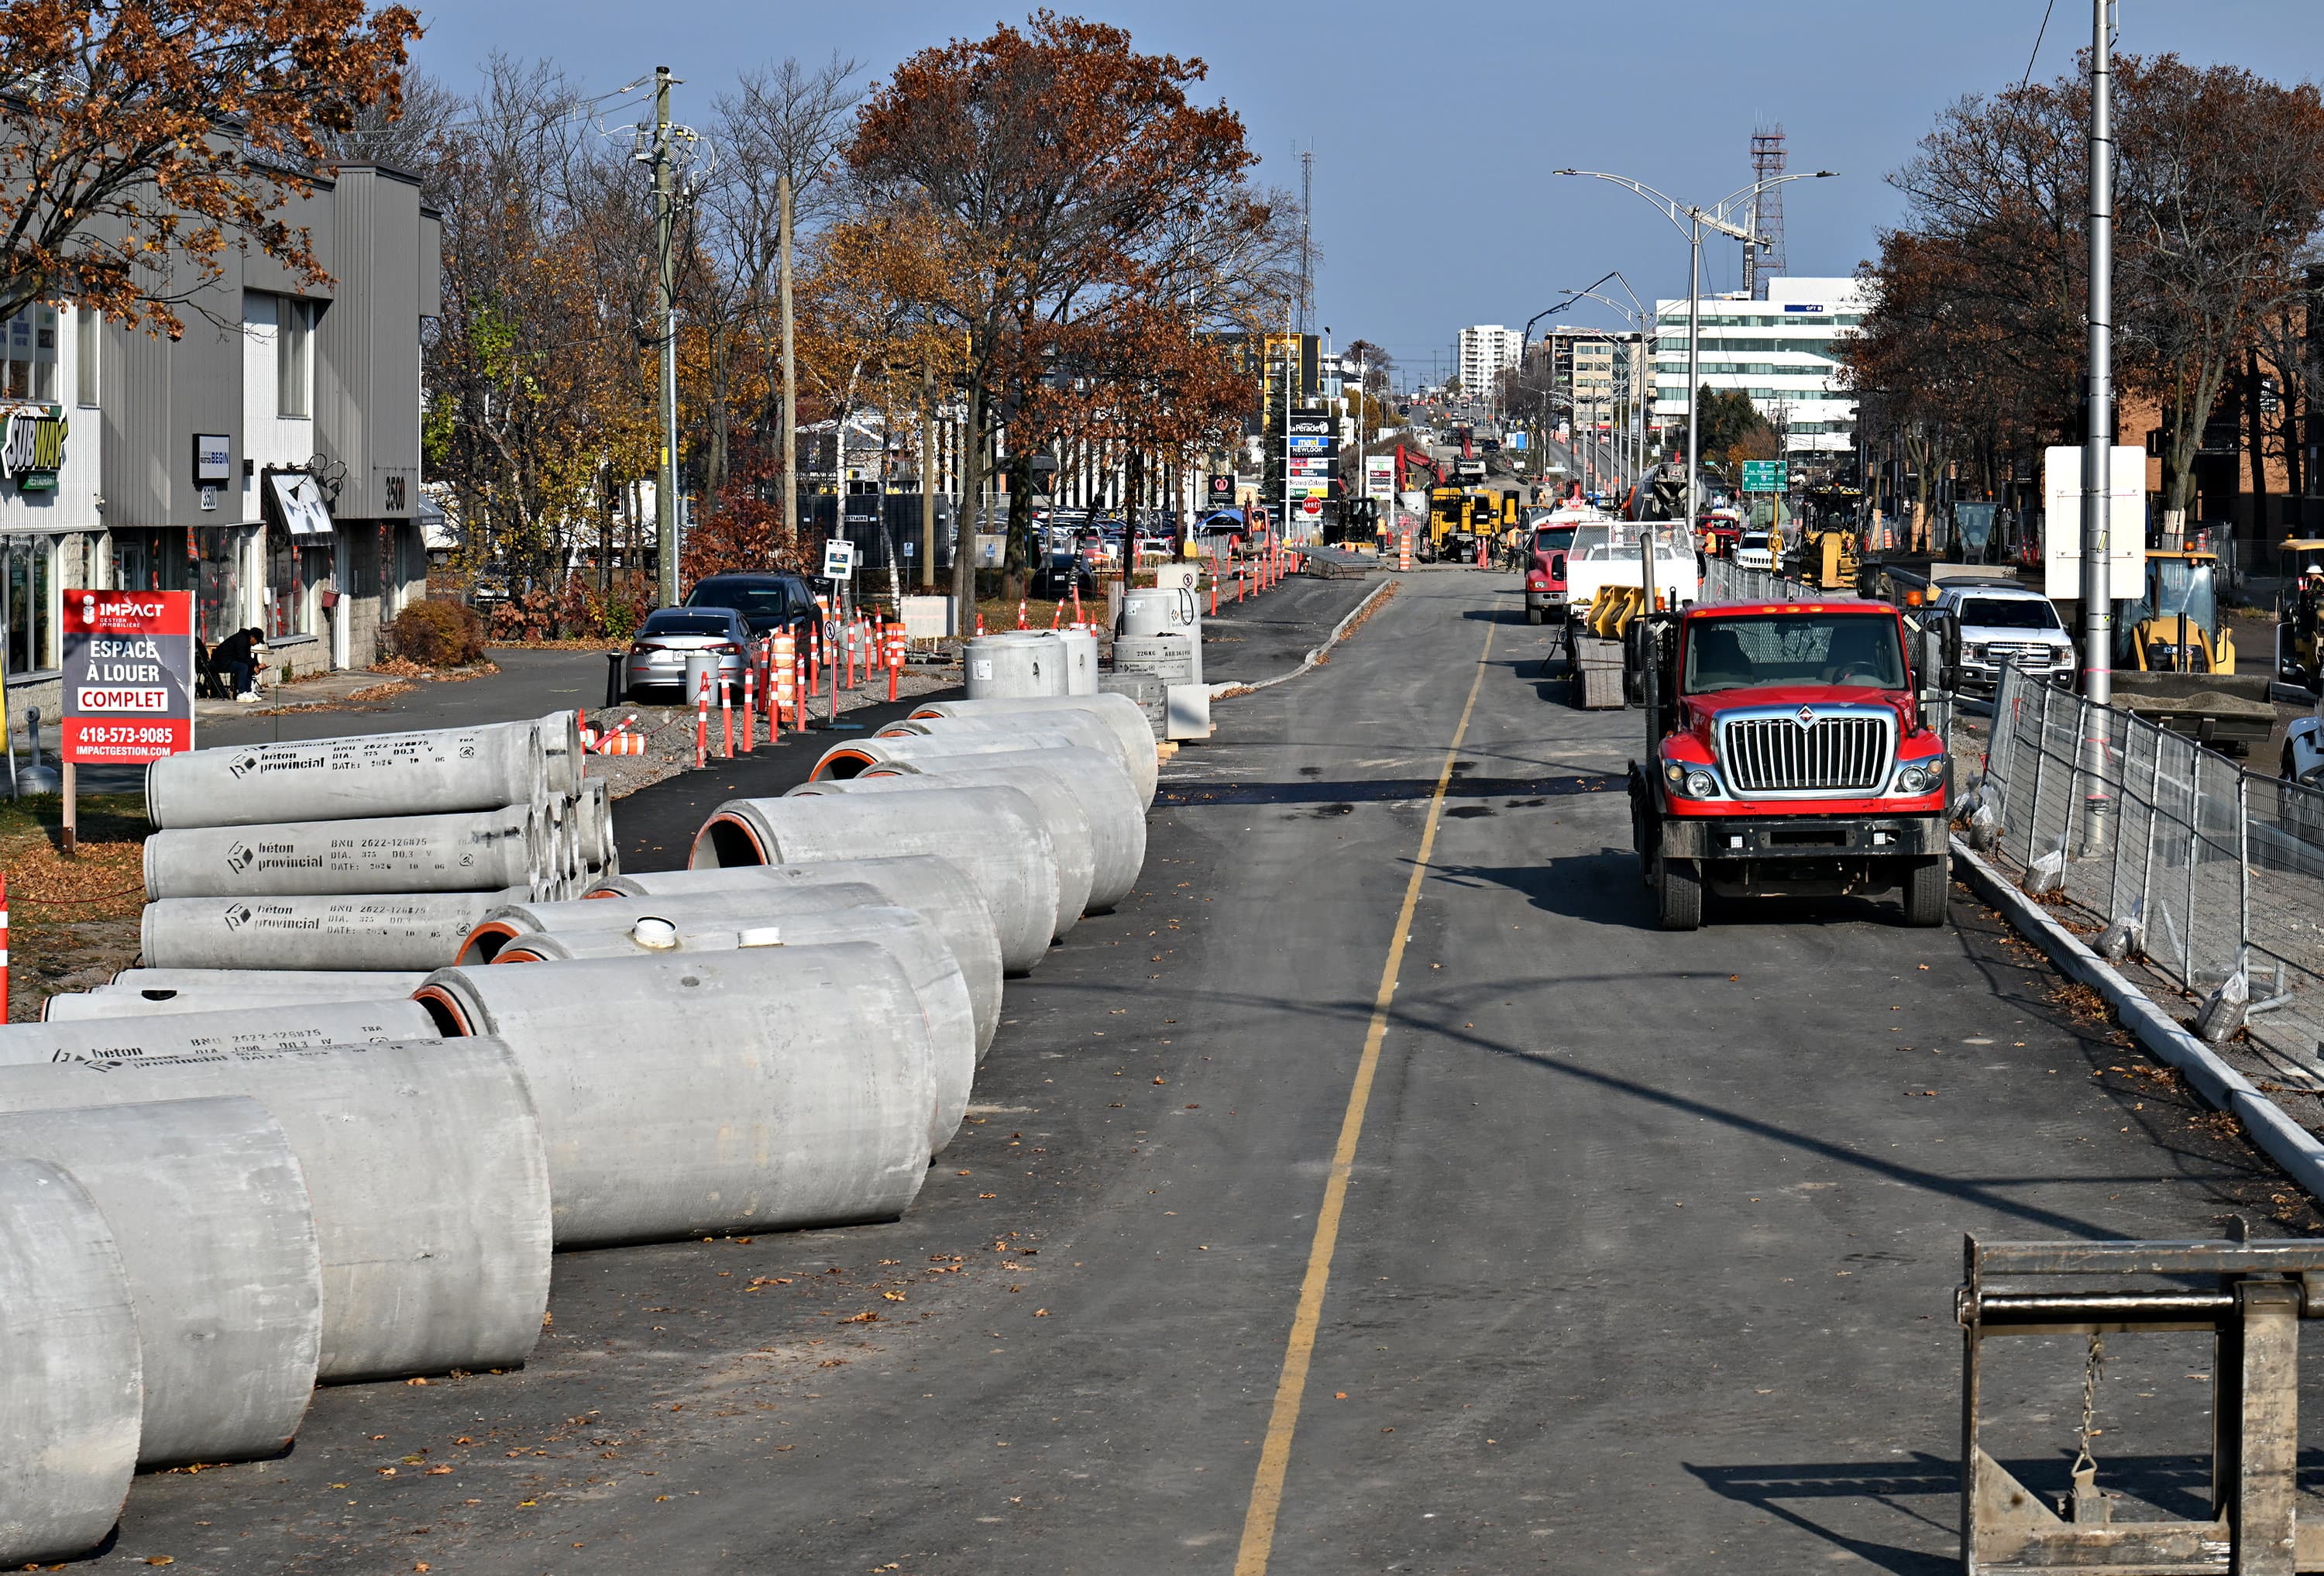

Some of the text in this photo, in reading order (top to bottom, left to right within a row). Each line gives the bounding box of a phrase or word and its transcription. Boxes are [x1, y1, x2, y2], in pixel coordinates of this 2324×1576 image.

[5, 418, 69, 467] SUBWAY
[1298, 436, 1318, 446] maxi
[211, 452, 229, 464] BEGIN
[29, 474, 55, 486] RESTAURANT
[202, 487, 216, 508] 3500
[386, 476, 405, 511] 3500
[99, 603, 164, 618] IMPACT
[91, 640, 156, 659] ESPACE
[86, 659, 160, 682] À LOUER
[82, 691, 164, 707] COMPLET
[79, 727, 173, 744] 418-573-9085
[76, 745, 171, 756] IMPACTGESTION.COM
[260, 751, 297, 762] béton
[260, 756, 325, 774] provincial
[332, 762, 361, 771] DATE:
[258, 842, 294, 854] béton
[331, 838, 427, 848] BNQ 2622-126875
[331, 851, 352, 859] DIA.
[258, 855, 323, 872] provincial
[331, 862, 360, 871] DATE:
[257, 904, 293, 915] béton
[359, 905, 426, 914] 2622-126875
[254, 917, 320, 931] provincial
[327, 926, 356, 934] DATE:
[91, 1047, 143, 1059] béton
